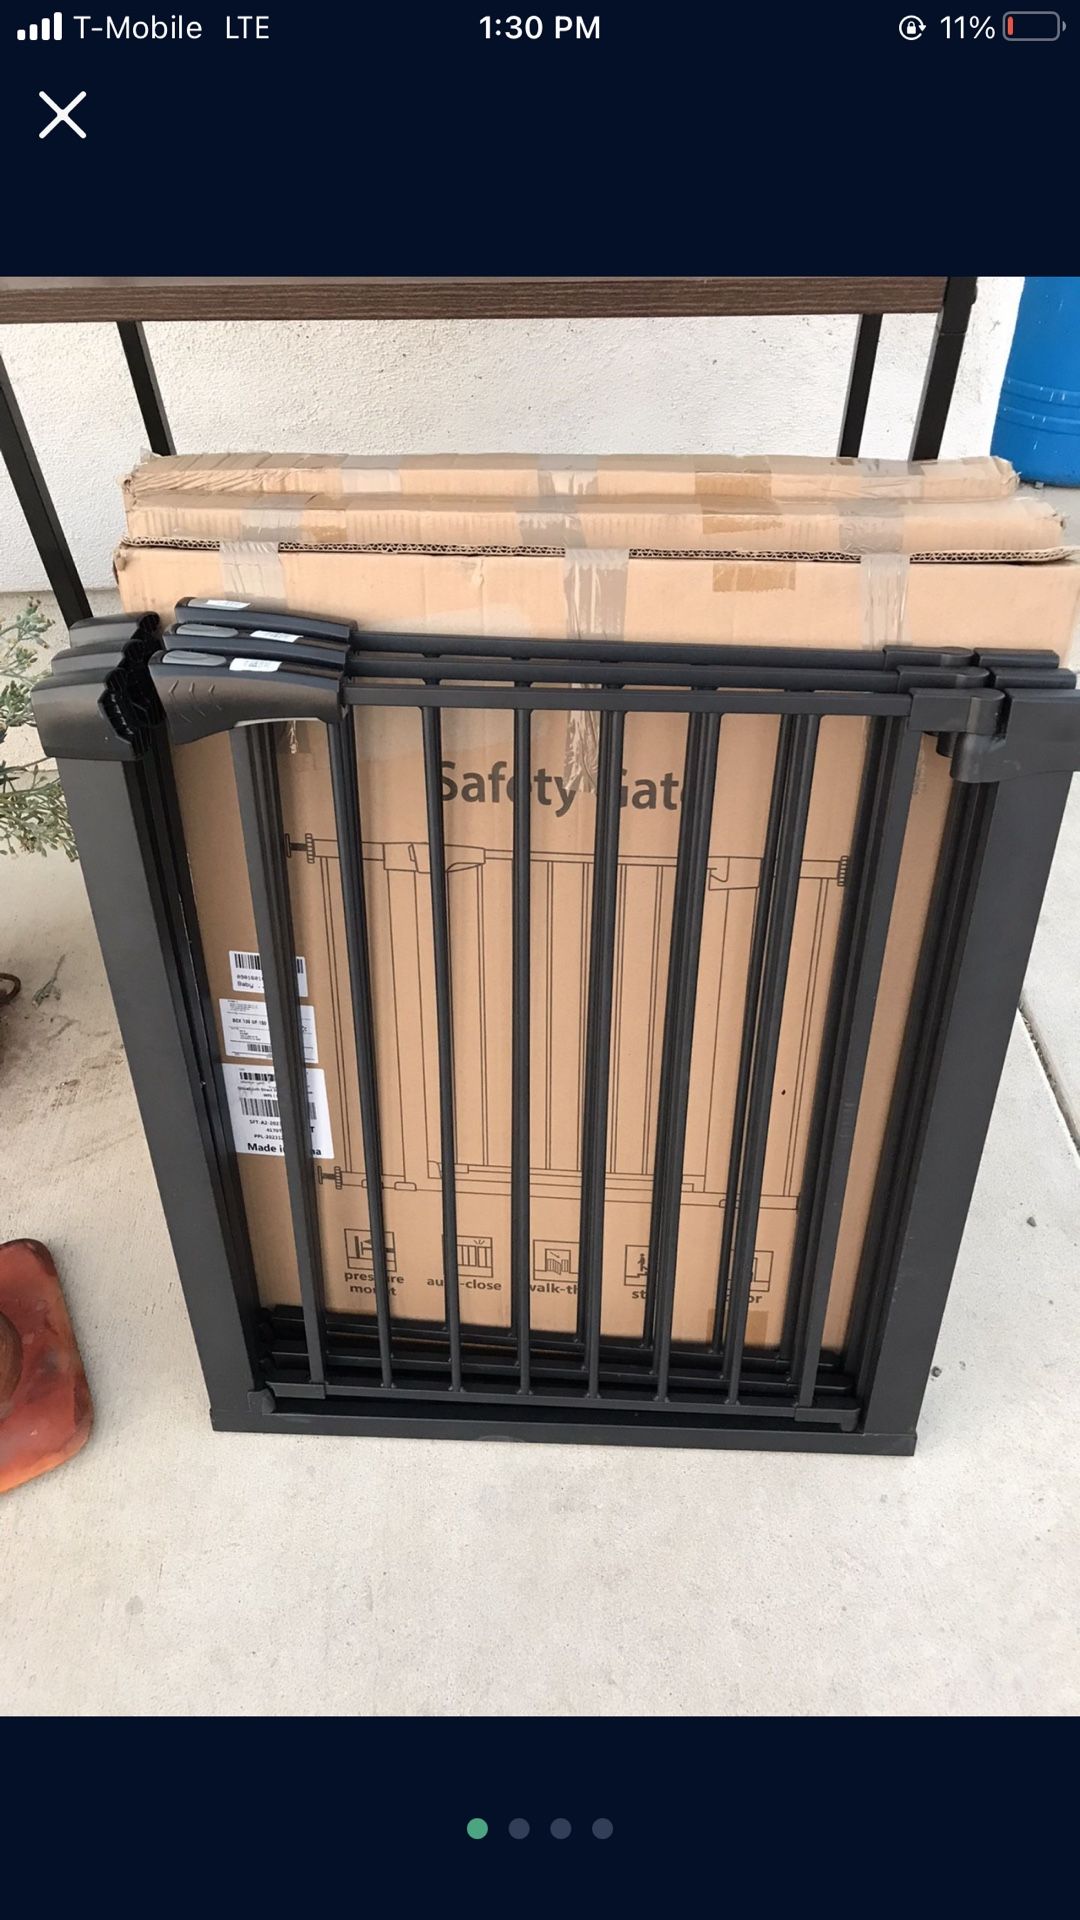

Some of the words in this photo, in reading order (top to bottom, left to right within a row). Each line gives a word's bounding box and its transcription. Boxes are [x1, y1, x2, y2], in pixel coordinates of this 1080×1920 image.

[441, 761, 579, 817] Safty
[247, 1142, 277, 1152] Made
[345, 1272, 405, 1284] presre
[427, 1278, 502, 1291] au-close
